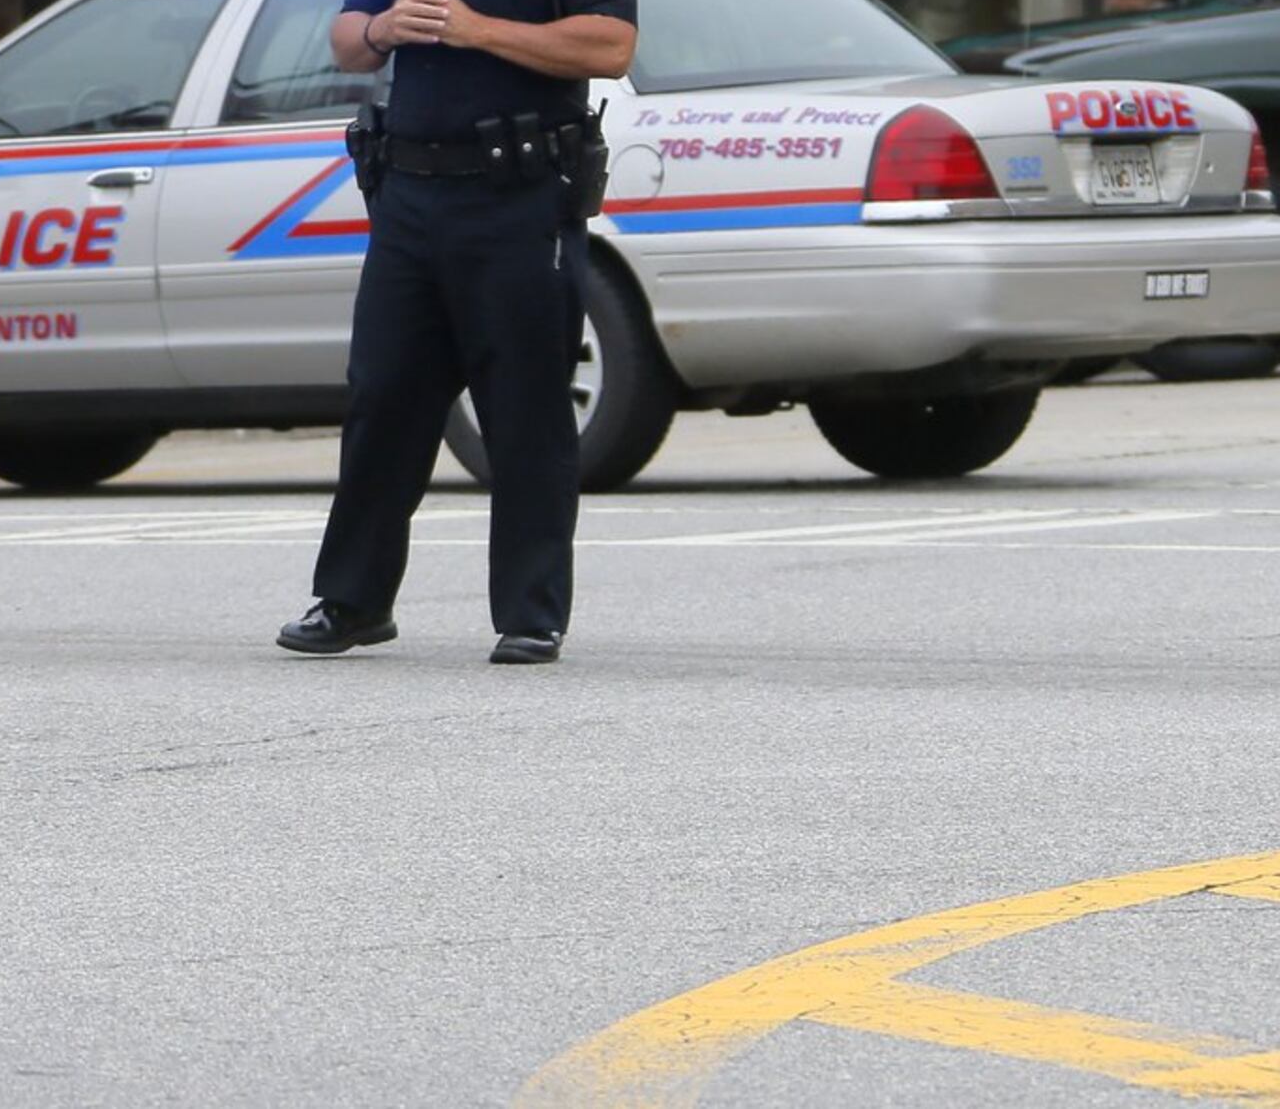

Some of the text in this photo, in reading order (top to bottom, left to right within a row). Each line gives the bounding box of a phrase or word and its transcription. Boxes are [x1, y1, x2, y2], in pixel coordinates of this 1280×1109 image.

[633, 107, 882, 127] To Serve and Protect
[1046, 89, 1198, 134] POLICE
[658, 137, 844, 159] 706-485-3551
